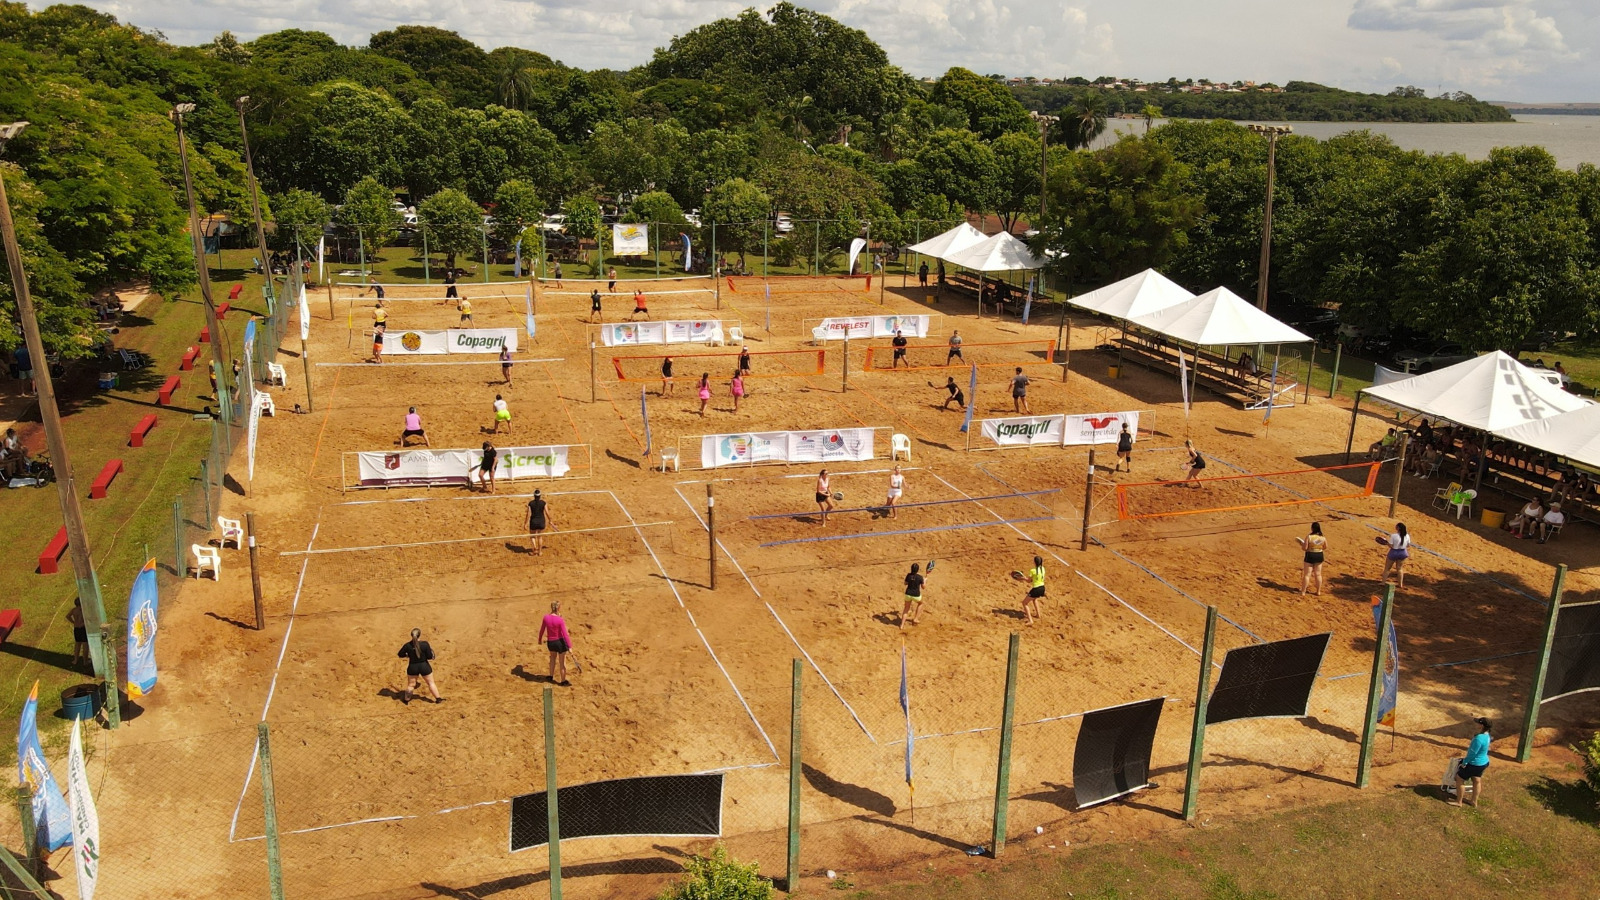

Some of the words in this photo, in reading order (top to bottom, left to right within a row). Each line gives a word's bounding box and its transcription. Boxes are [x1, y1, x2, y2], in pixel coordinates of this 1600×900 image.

[457, 333, 506, 349] Copagril
[997, 419, 1051, 439] Copagril
[401, 454, 446, 464] CAMARIM
[503, 451, 558, 469] Sicredi
